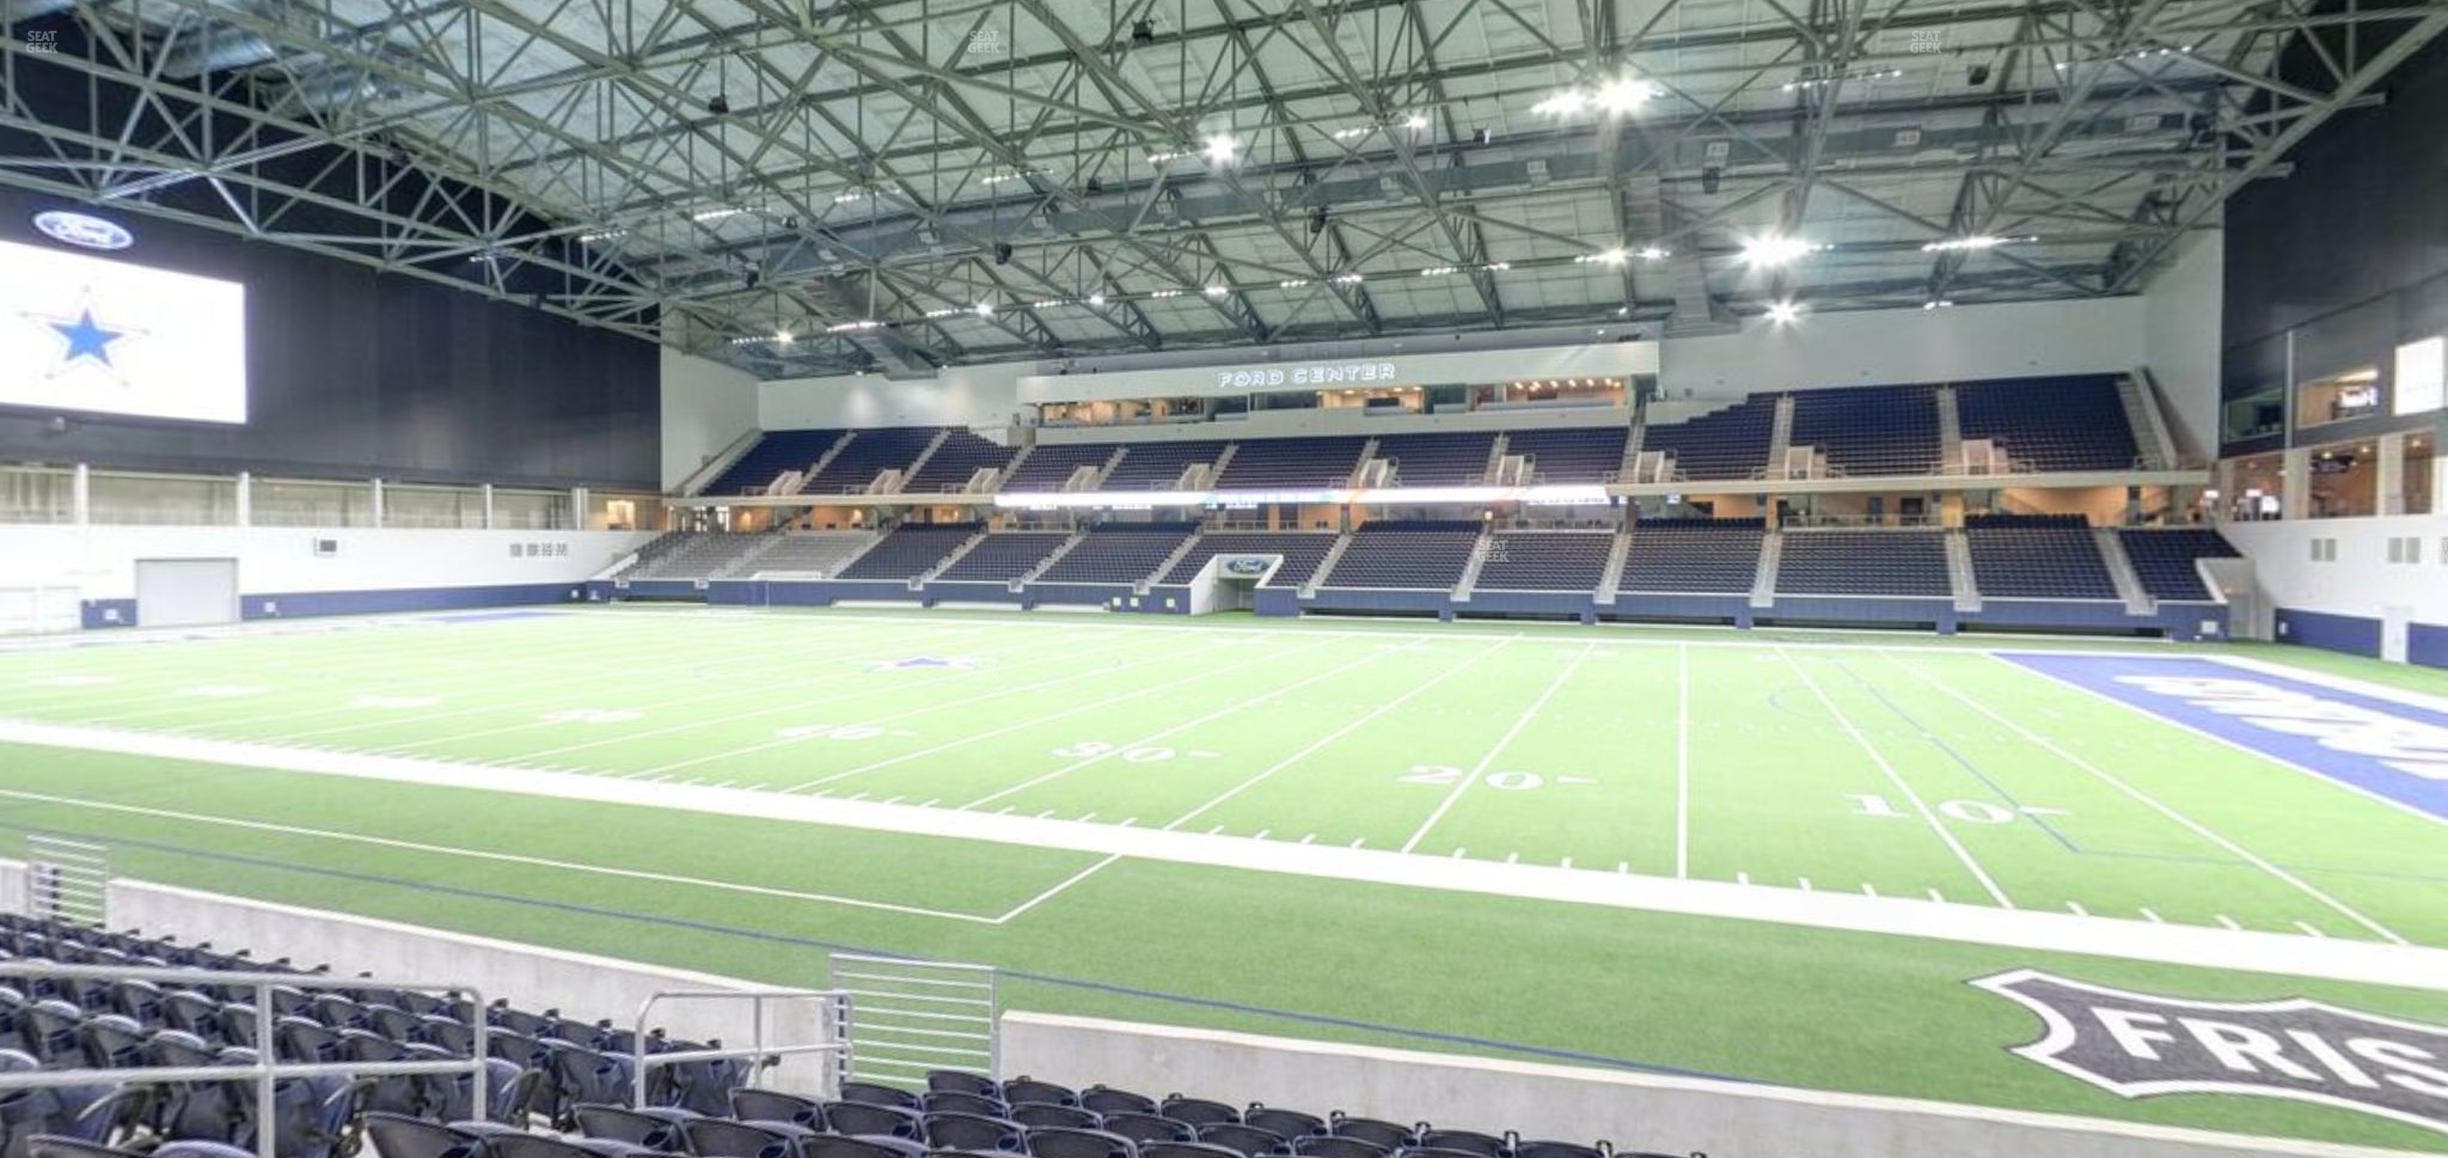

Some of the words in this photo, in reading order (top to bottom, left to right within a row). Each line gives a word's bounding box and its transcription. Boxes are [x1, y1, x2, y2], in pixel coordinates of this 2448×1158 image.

[1217, 369, 1285, 388] FORD
[1292, 363, 1396, 384] CENTER
[1396, 764, 1544, 790] 20
[1843, 793, 2015, 824] 10
